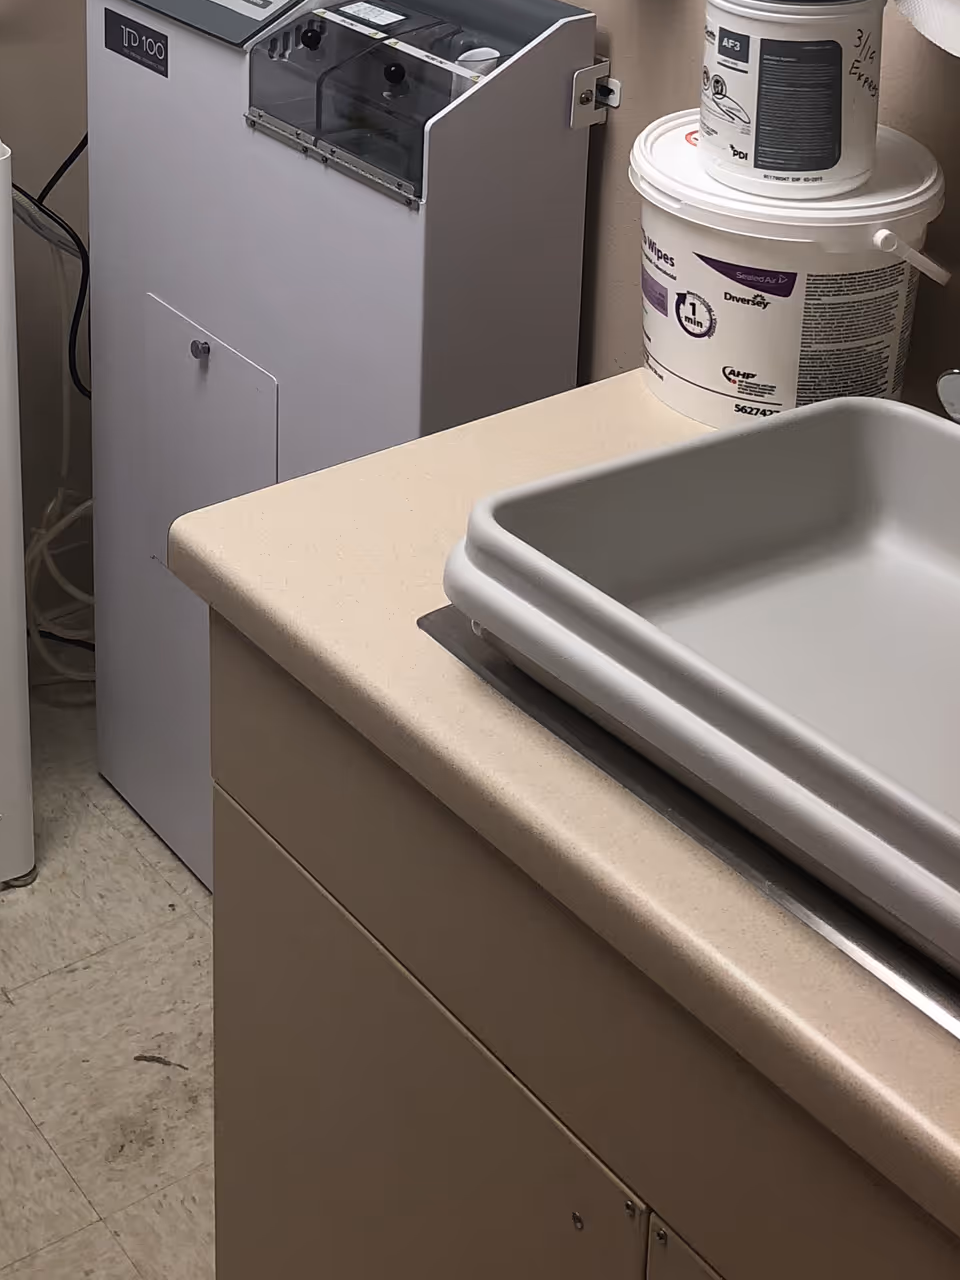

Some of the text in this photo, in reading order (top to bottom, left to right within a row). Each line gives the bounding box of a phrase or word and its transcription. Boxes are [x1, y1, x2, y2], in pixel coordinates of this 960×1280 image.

[142, 36, 164, 60] 100
[722, 38, 740, 50] AF3
[732, 150, 748, 160] PDI
[648, 236, 675, 267] Wipes
[724, 292, 771, 310] Diversey
[690, 302, 696, 316] 1
[684, 316, 703, 328] min
[728, 370, 757, 379] AHP
[734, 404, 780, 416] 562742
